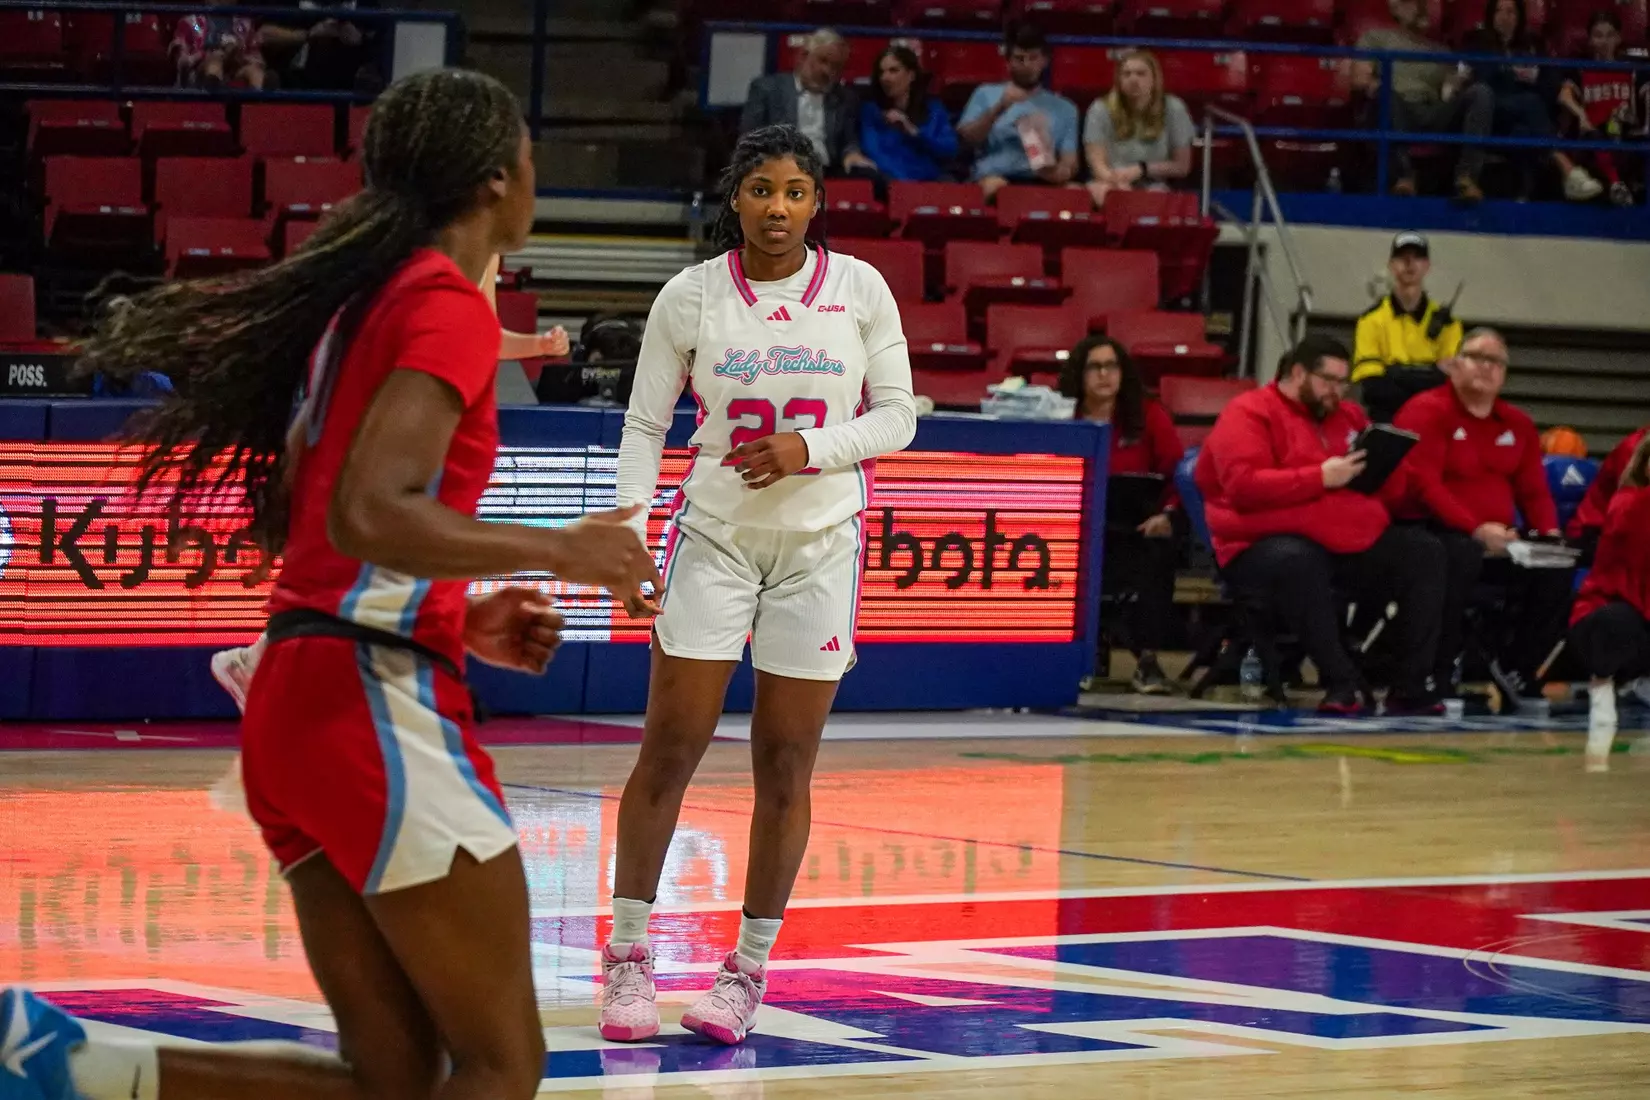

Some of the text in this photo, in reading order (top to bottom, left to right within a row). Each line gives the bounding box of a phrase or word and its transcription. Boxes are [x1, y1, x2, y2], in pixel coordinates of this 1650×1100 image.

[8, 364, 48, 387] POSS.
[713, 345, 846, 385] Lady Techsters
[866, 506, 1050, 590] bota
